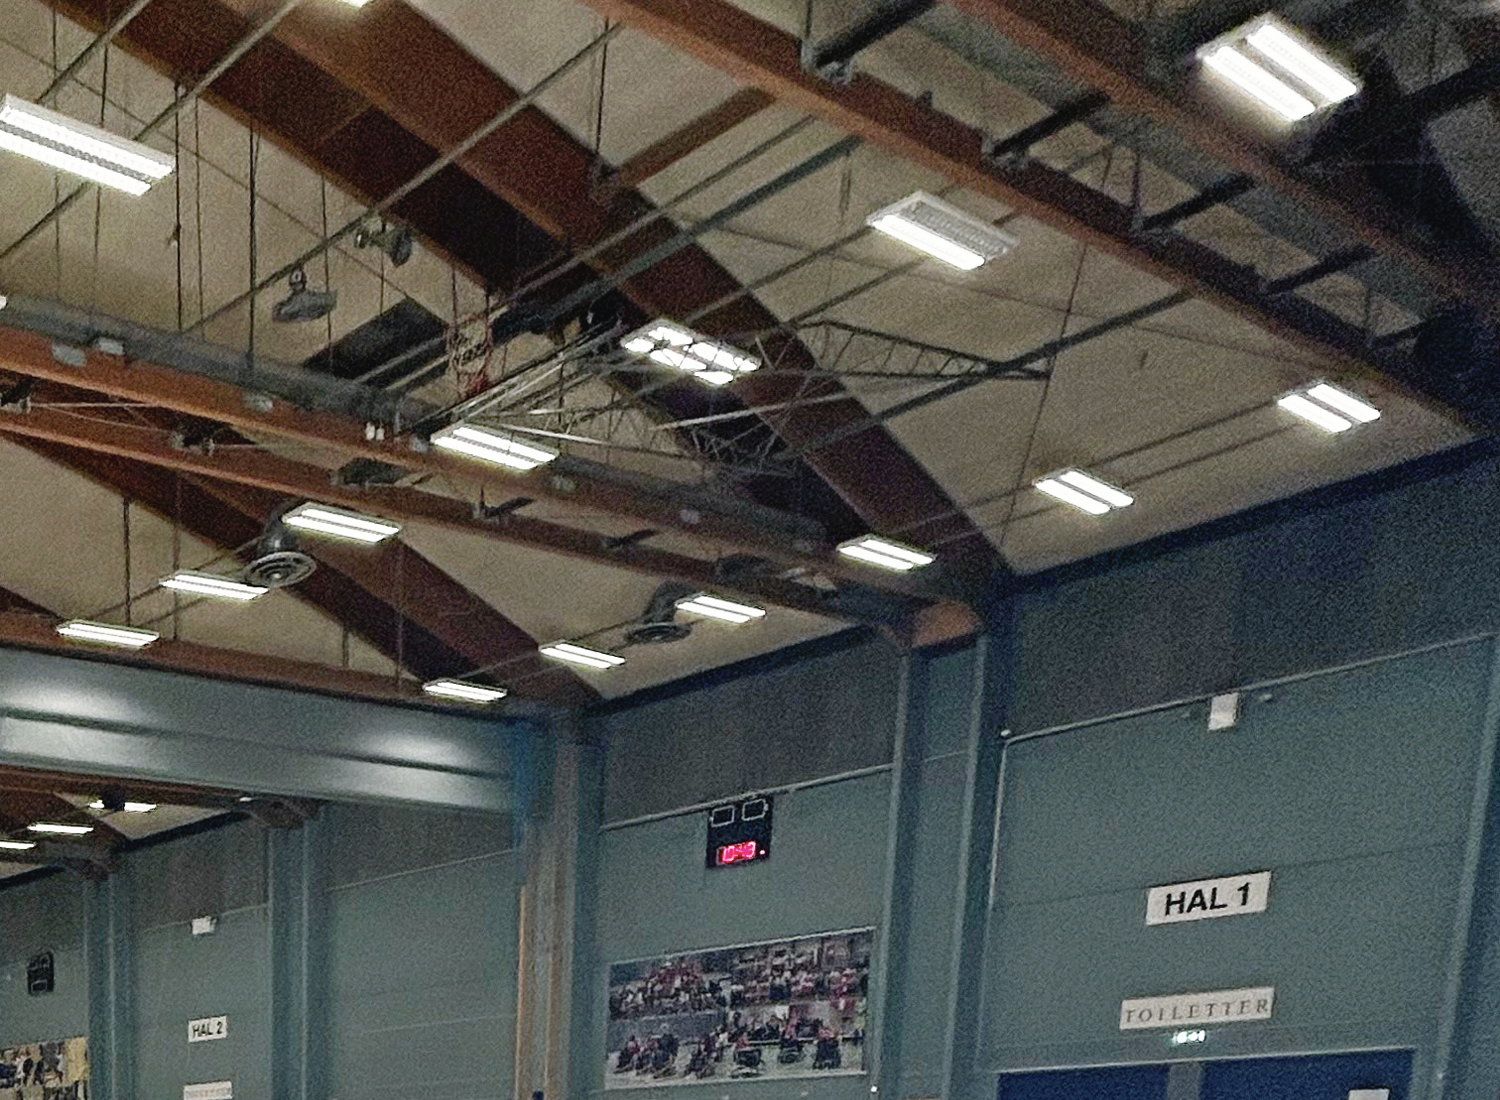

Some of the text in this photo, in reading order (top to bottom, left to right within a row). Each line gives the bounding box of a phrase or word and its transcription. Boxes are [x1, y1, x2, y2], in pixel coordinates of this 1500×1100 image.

[1164, 881, 1251, 916] HAL 1
[1125, 998, 1269, 1023] TOILETTER
[192, 1021, 224, 1039] HAL 2
